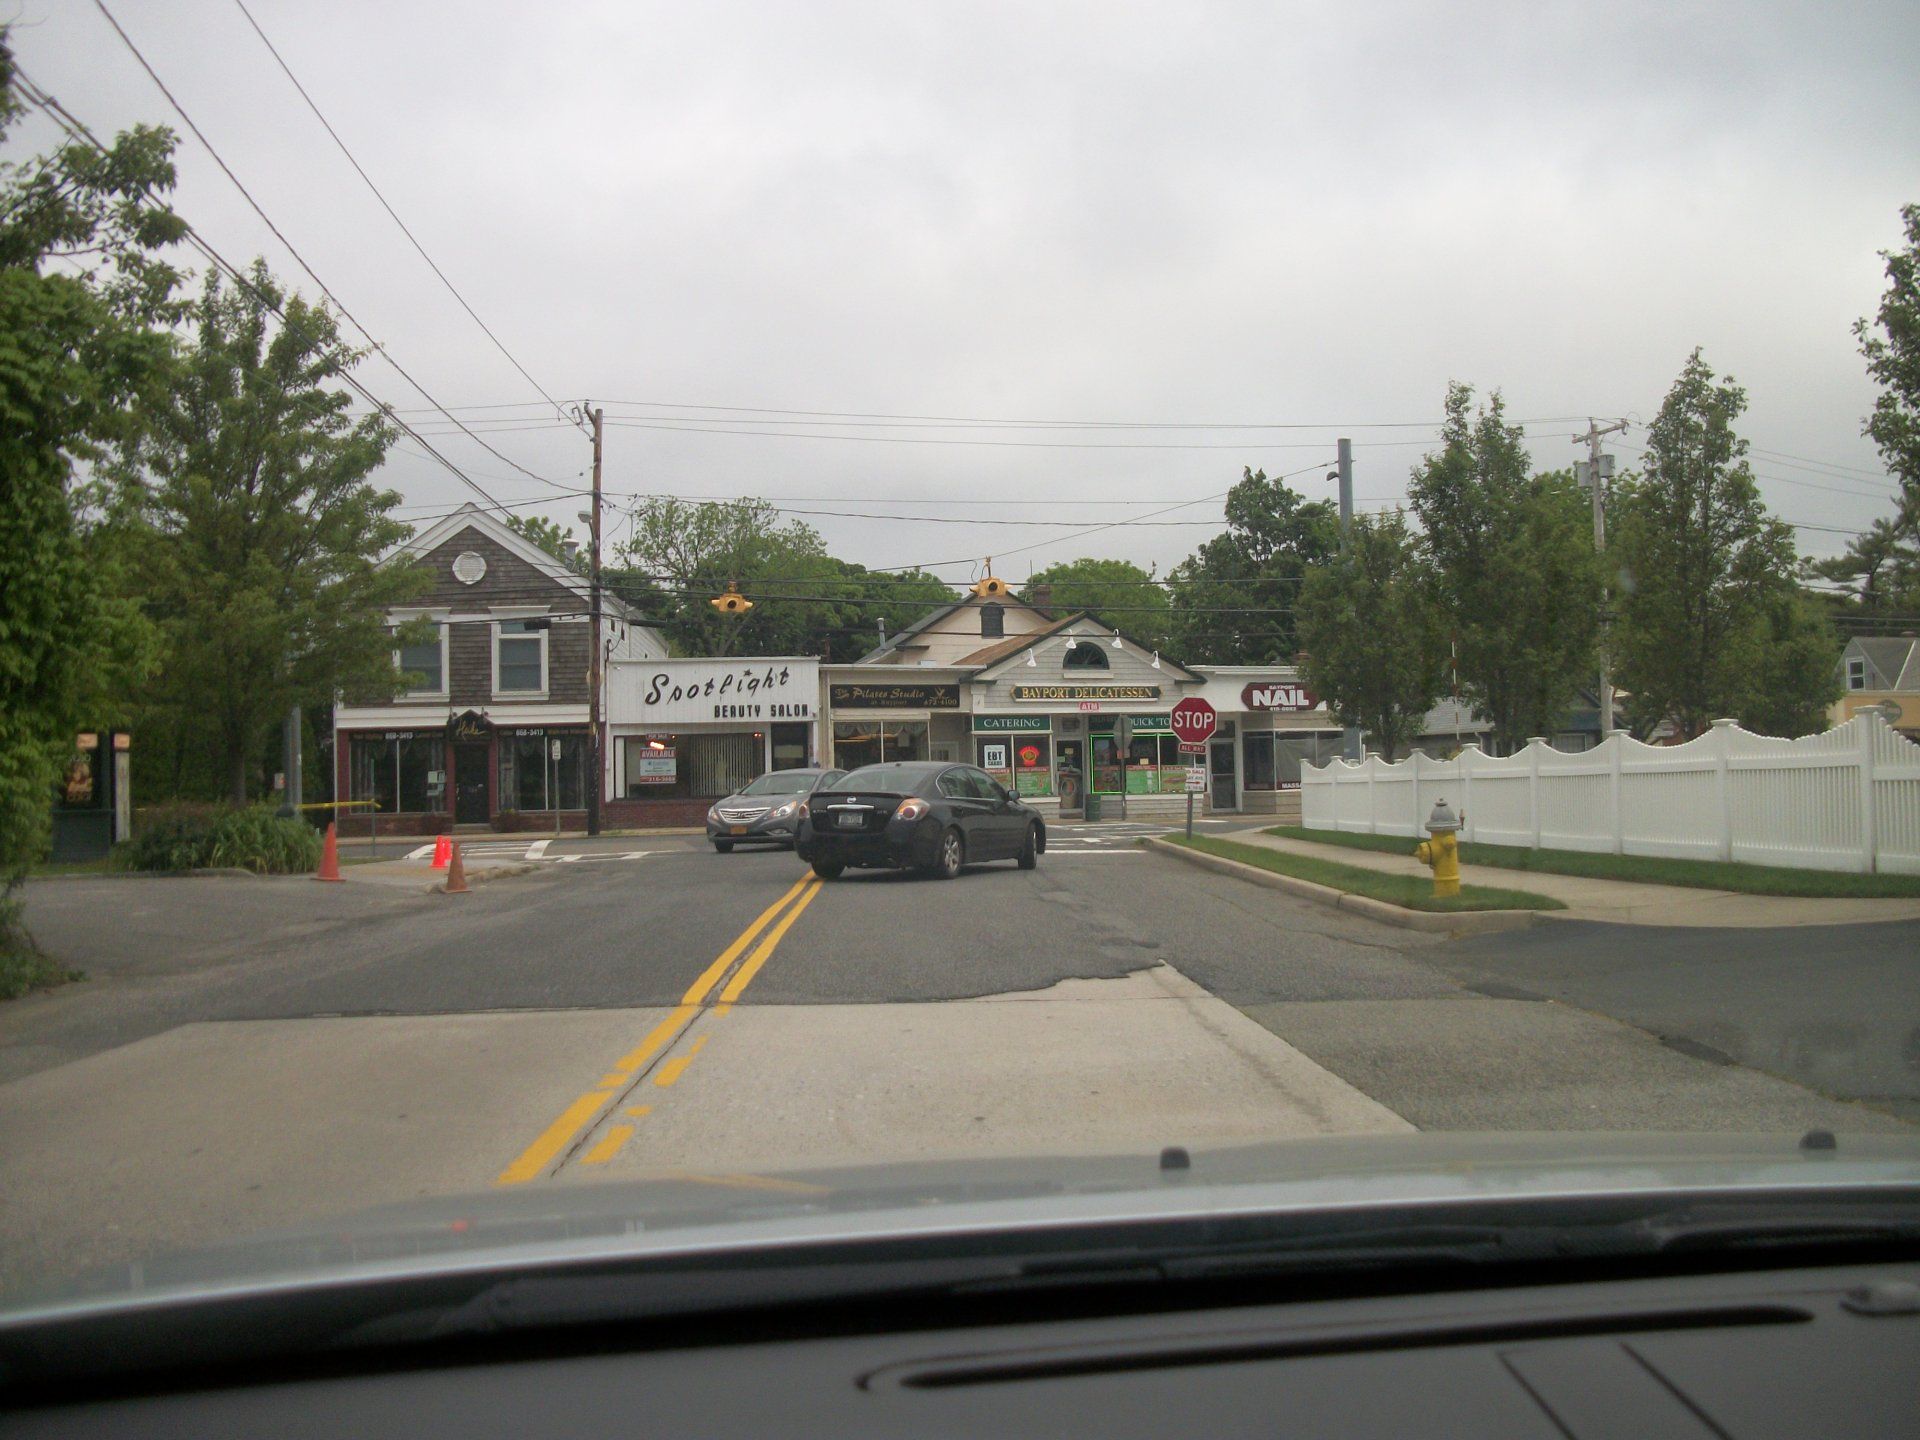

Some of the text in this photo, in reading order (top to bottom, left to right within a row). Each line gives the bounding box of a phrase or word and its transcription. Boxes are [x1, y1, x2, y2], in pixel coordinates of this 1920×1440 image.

[644, 666, 790, 705] Spotlight
[852, 687, 889, 699] Pilates
[889, 687, 925, 699] Studio
[1022, 687, 1152, 698] BAYPORT DELICATESSEN
[1252, 690, 1309, 706] NAIL
[714, 704, 808, 718] BEAUTY SALON
[983, 718, 1040, 727] CATERING
[1130, 717, 1154, 726] UICK
[1174, 711, 1214, 729] STOP
[987, 751, 1002, 761] EBT
